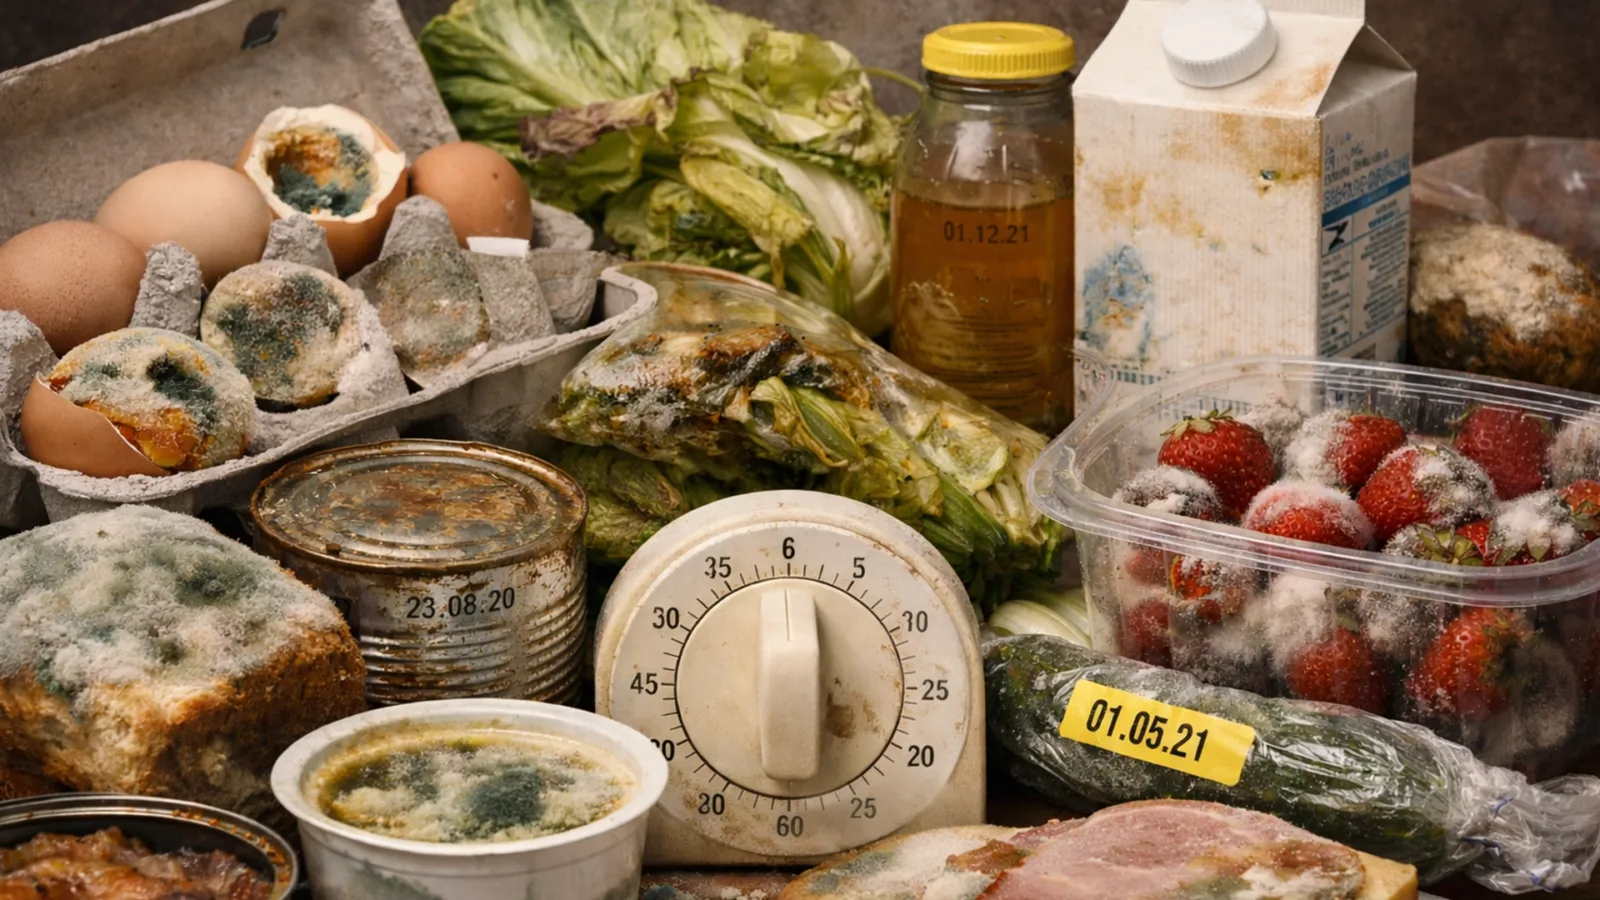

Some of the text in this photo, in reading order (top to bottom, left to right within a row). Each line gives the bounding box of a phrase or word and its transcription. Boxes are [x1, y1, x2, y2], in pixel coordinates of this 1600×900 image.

[944, 221, 1029, 244] 01.12.21
[782, 536, 796, 560] 6
[704, 556, 732, 580] 35
[852, 556, 866, 579] 5
[406, 587, 515, 618] 23.08.20
[652, 606, 680, 630] 30
[630, 672, 659, 696] 45
[921, 678, 949, 701] 25
[1086, 699, 1208, 762] 01.05.21
[907, 744, 935, 768] 20
[850, 797, 877, 819] 25
[776, 814, 804, 838] 60
